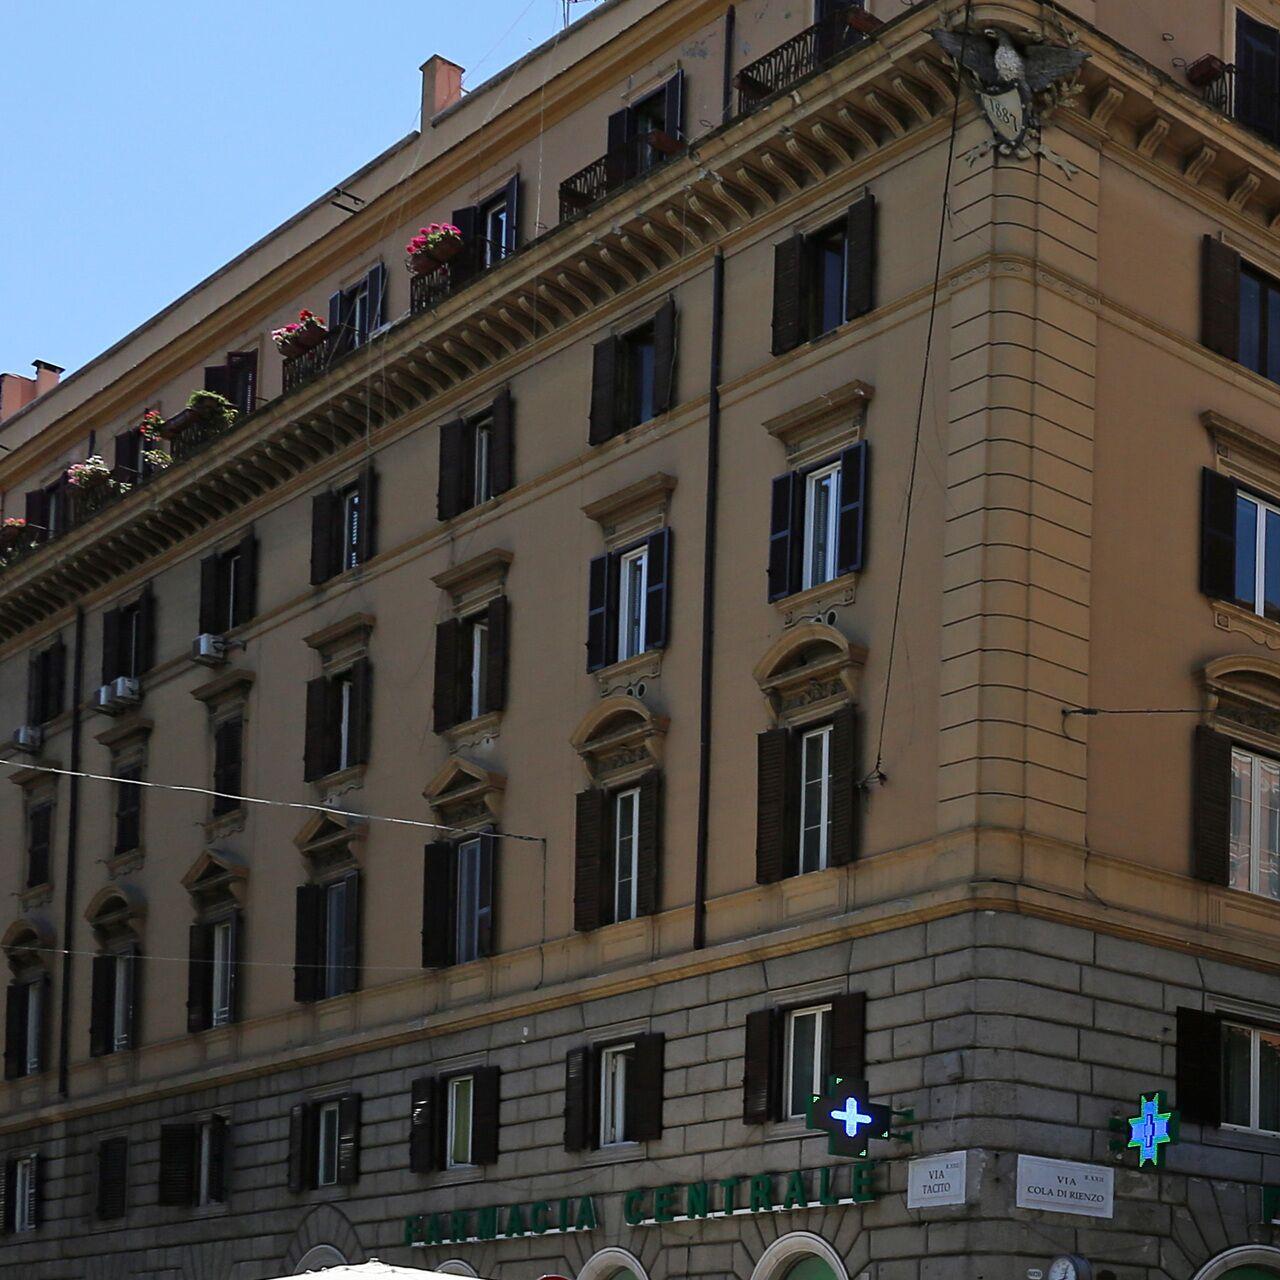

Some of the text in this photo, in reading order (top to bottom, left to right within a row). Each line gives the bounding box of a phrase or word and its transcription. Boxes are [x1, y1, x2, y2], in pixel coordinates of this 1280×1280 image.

[988, 97, 1018, 132] 1887
[928, 1170, 945, 1180] VIA
[1056, 1176, 1077, 1186] VIA
[922, 1183, 951, 1195] TACITO
[1027, 1185, 1105, 1203] COLA DI RIENZO
[404, 1164, 877, 1247] FARMACIA CENTRALE
